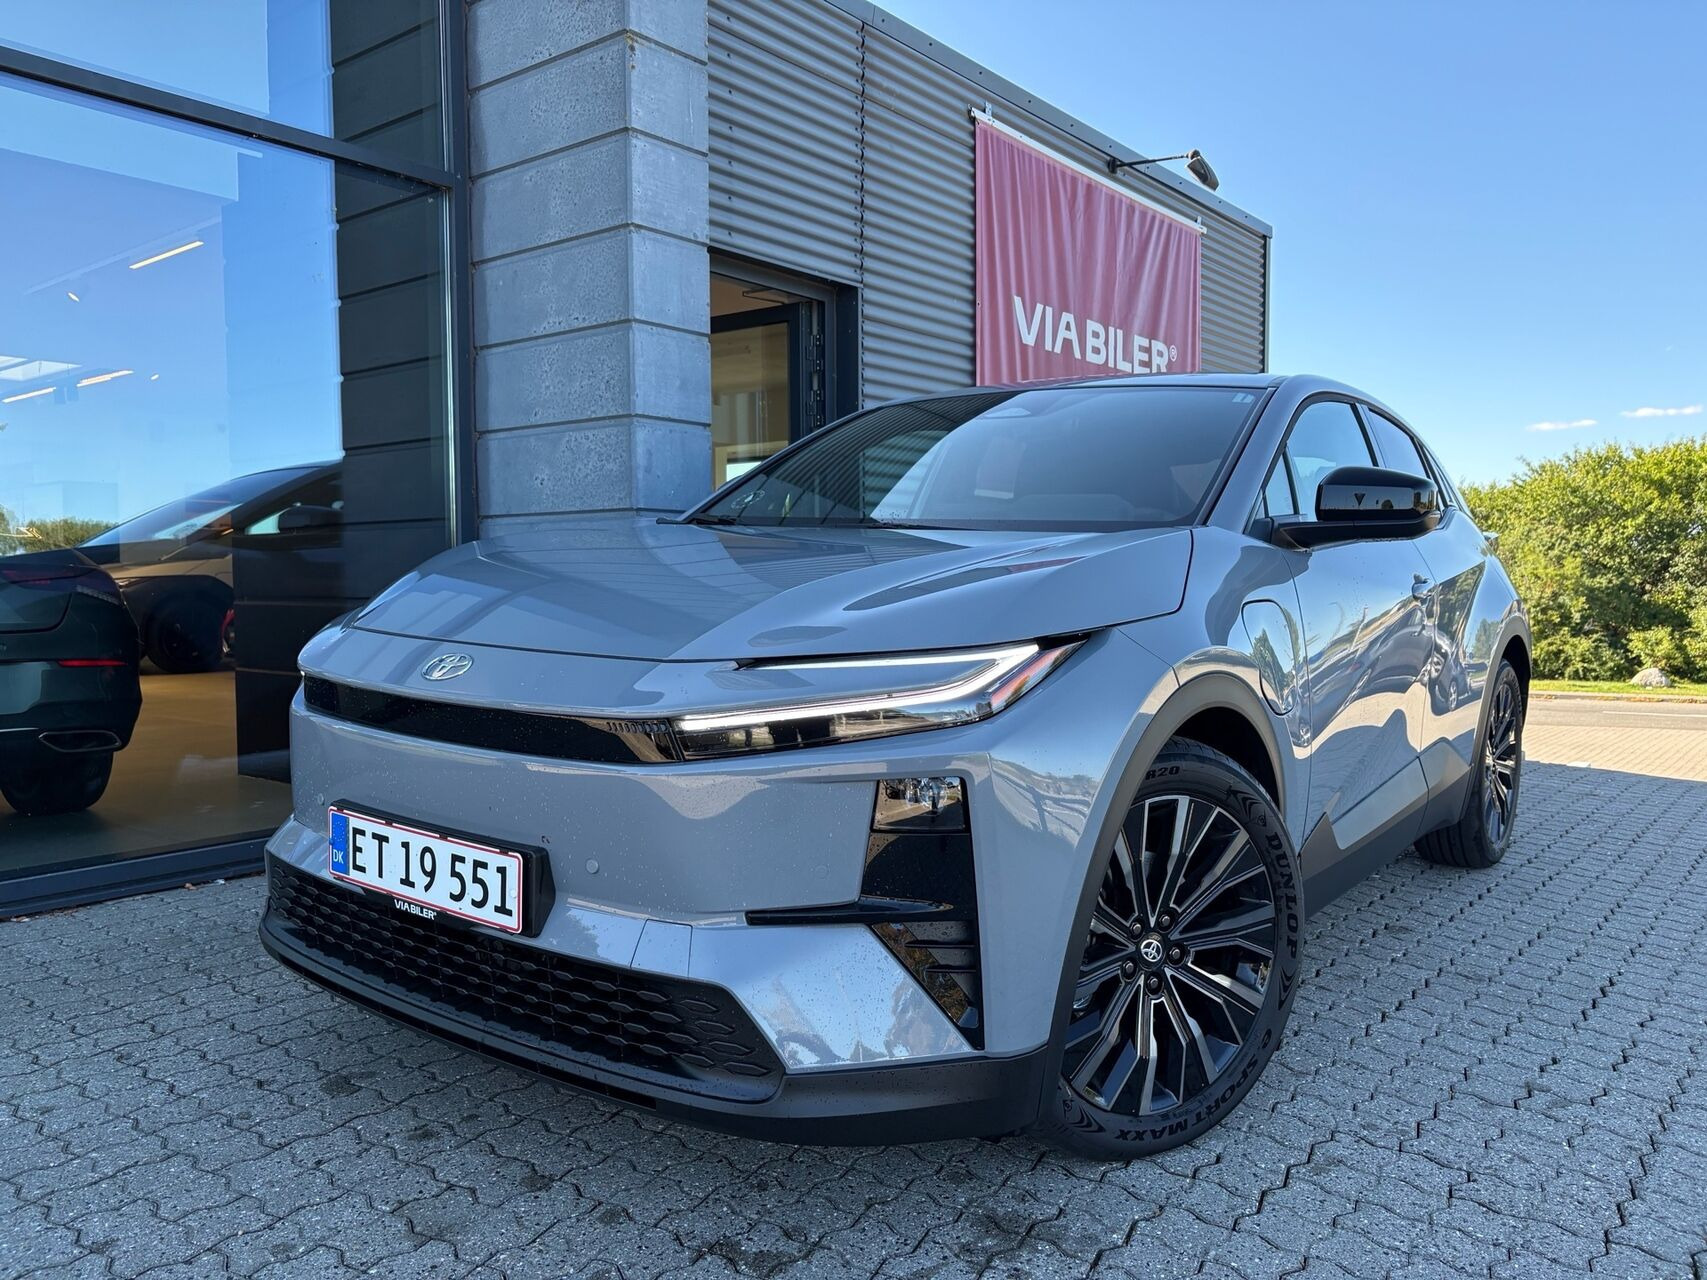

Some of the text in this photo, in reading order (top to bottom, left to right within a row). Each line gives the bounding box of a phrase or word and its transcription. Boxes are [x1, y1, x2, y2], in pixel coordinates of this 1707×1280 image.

[1013, 295, 1081, 359] VIA
[333, 849, 344, 864] DK
[352, 826, 513, 917] ET 19 551
[394, 899, 410, 912] VIA
[1265, 831, 1299, 959] DUNLOP
[1192, 1054, 1259, 1128] SPORT
[1115, 1118, 1188, 1141] MAXX
